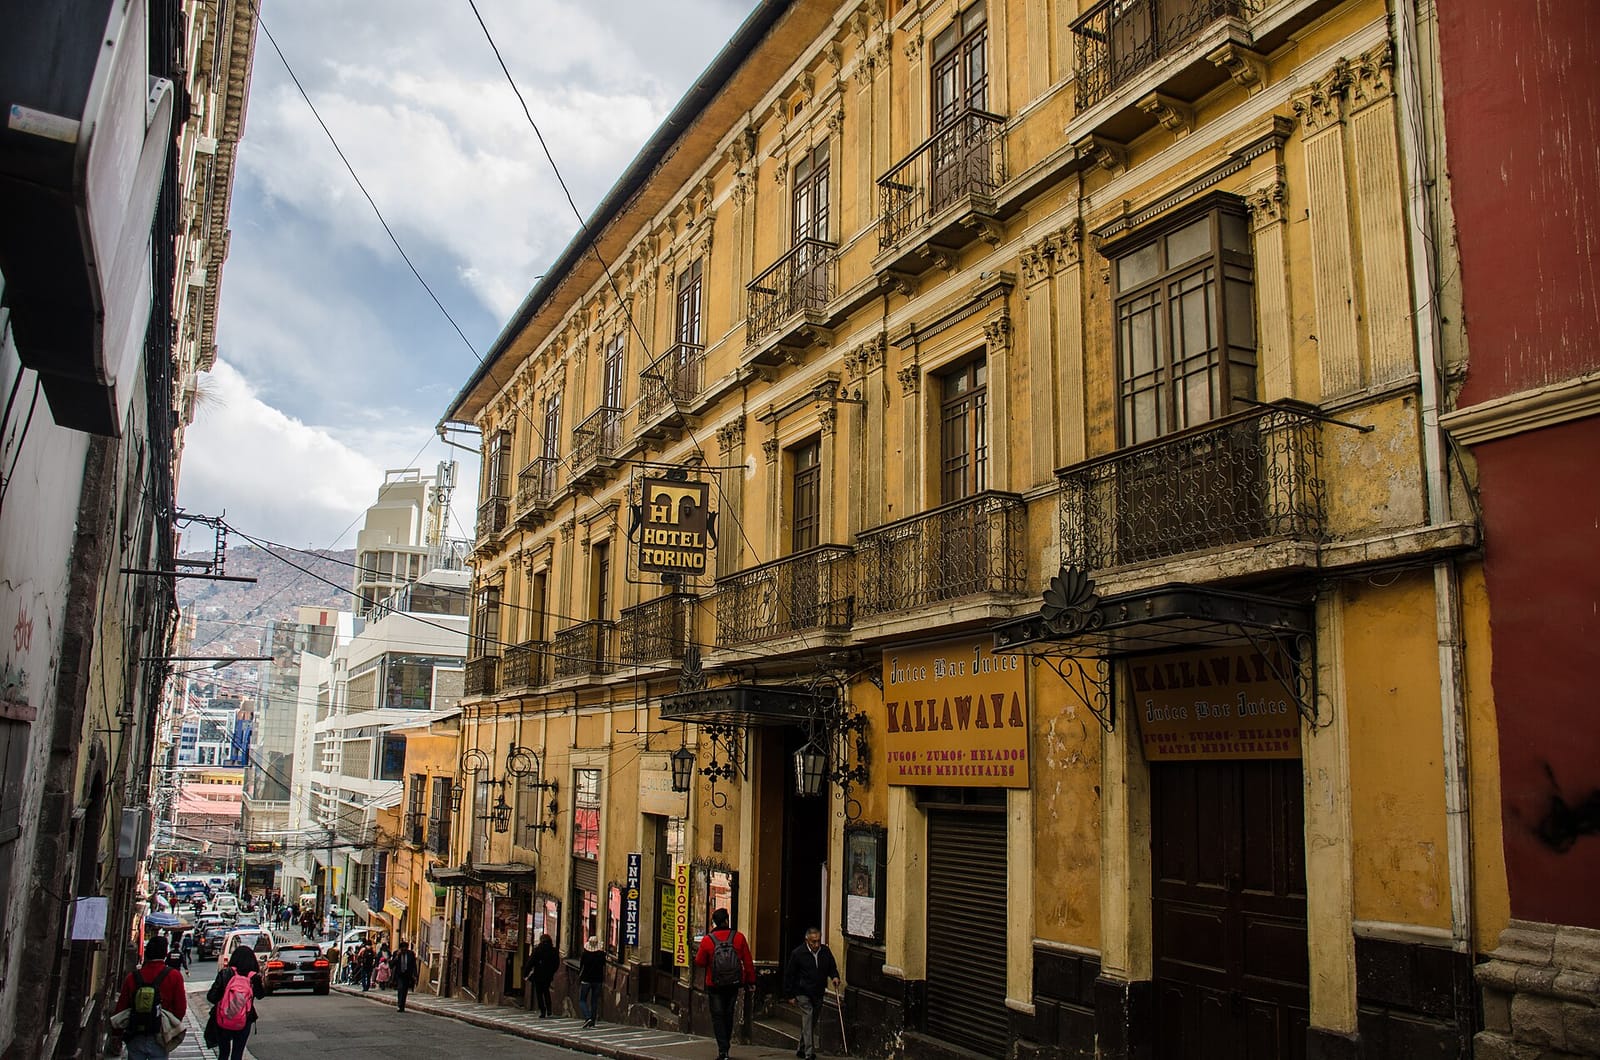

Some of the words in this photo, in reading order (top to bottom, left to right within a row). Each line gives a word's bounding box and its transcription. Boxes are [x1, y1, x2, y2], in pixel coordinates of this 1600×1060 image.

[644, 528, 704, 548] HOTEL
[642, 548, 704, 568] TORINO
[890, 656, 927, 686] Juice
[934, 657, 965, 682] Bar
[972, 645, 1018, 676] Juice
[1133, 651, 1291, 692] KALLAWAYA
[886, 691, 1024, 733] KALLAWAYA
[1145, 699, 1188, 724] Juice
[1195, 701, 1230, 720] Bar
[1237, 691, 1288, 719] Juice
[1143, 732, 1178, 745] JUGOS
[1238, 728, 1298, 740] HELADOS
[887, 751, 917, 763] JUGOS
[970, 749, 1025, 760] HELADOS
[1159, 744, 1197, 754] MATES
[1201, 742, 1289, 753] MEDICINALES
[899, 765, 932, 776] MATES
[936, 764, 1015, 777] MEDICINALES
[677, 865, 686, 964] FOTOCOPIAS
